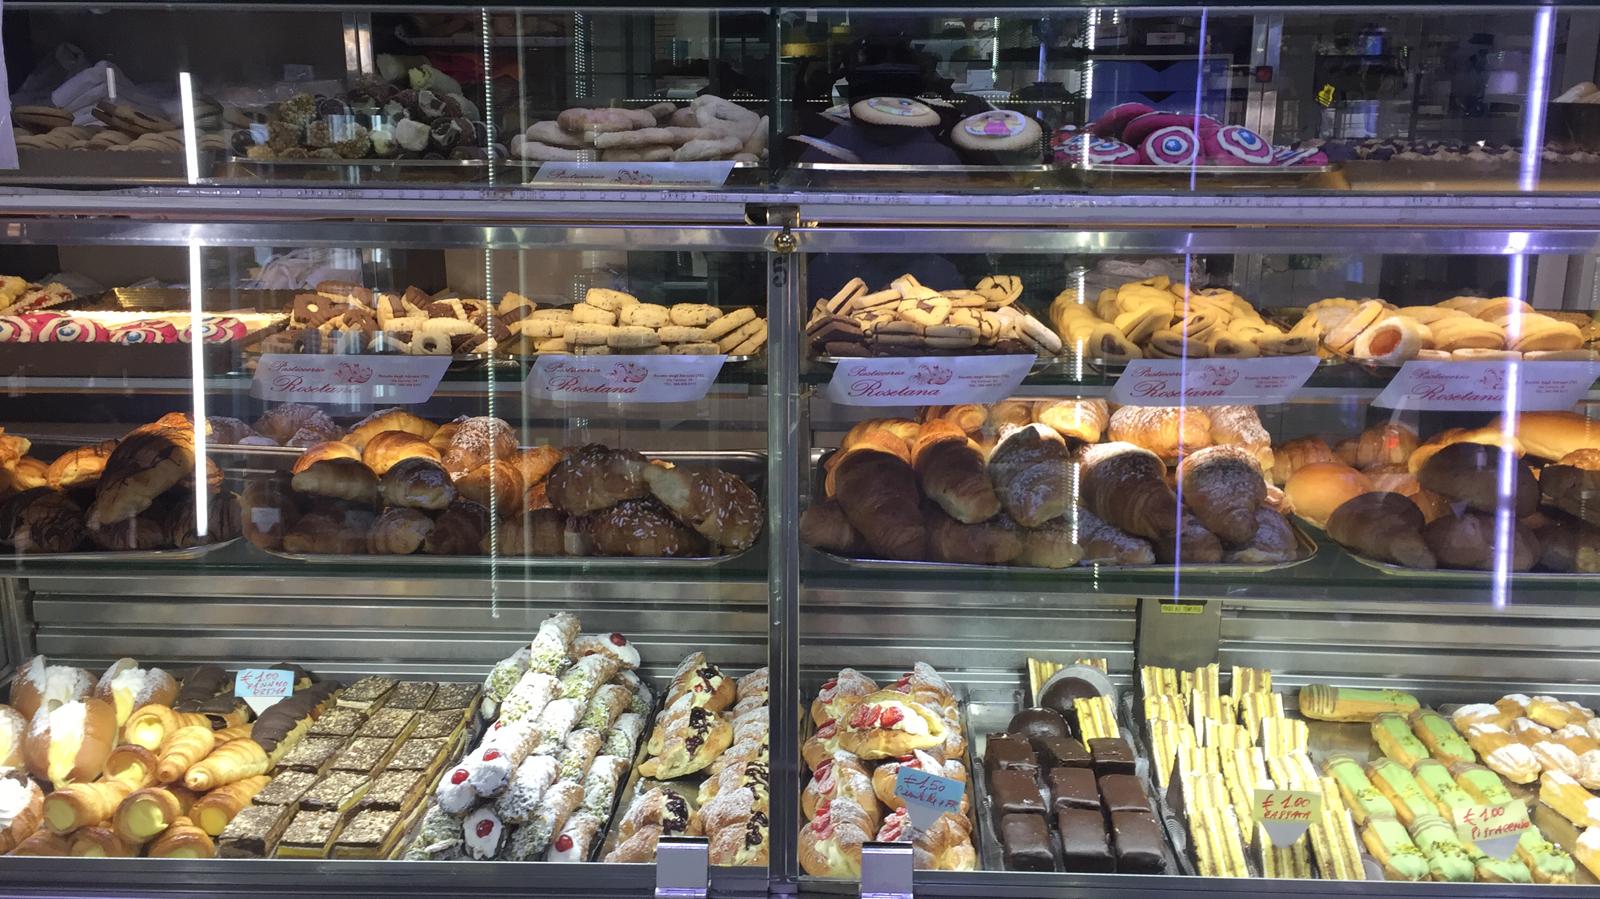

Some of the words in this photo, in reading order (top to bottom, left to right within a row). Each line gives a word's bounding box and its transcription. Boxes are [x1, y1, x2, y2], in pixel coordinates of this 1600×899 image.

[546, 376, 638, 394] Rosetana
[848, 378, 941, 397] Rosetana
[1130, 380, 1224, 398] Rosetana
[1261, 793, 1274, 810] €
[1462, 808, 1477, 826] €
